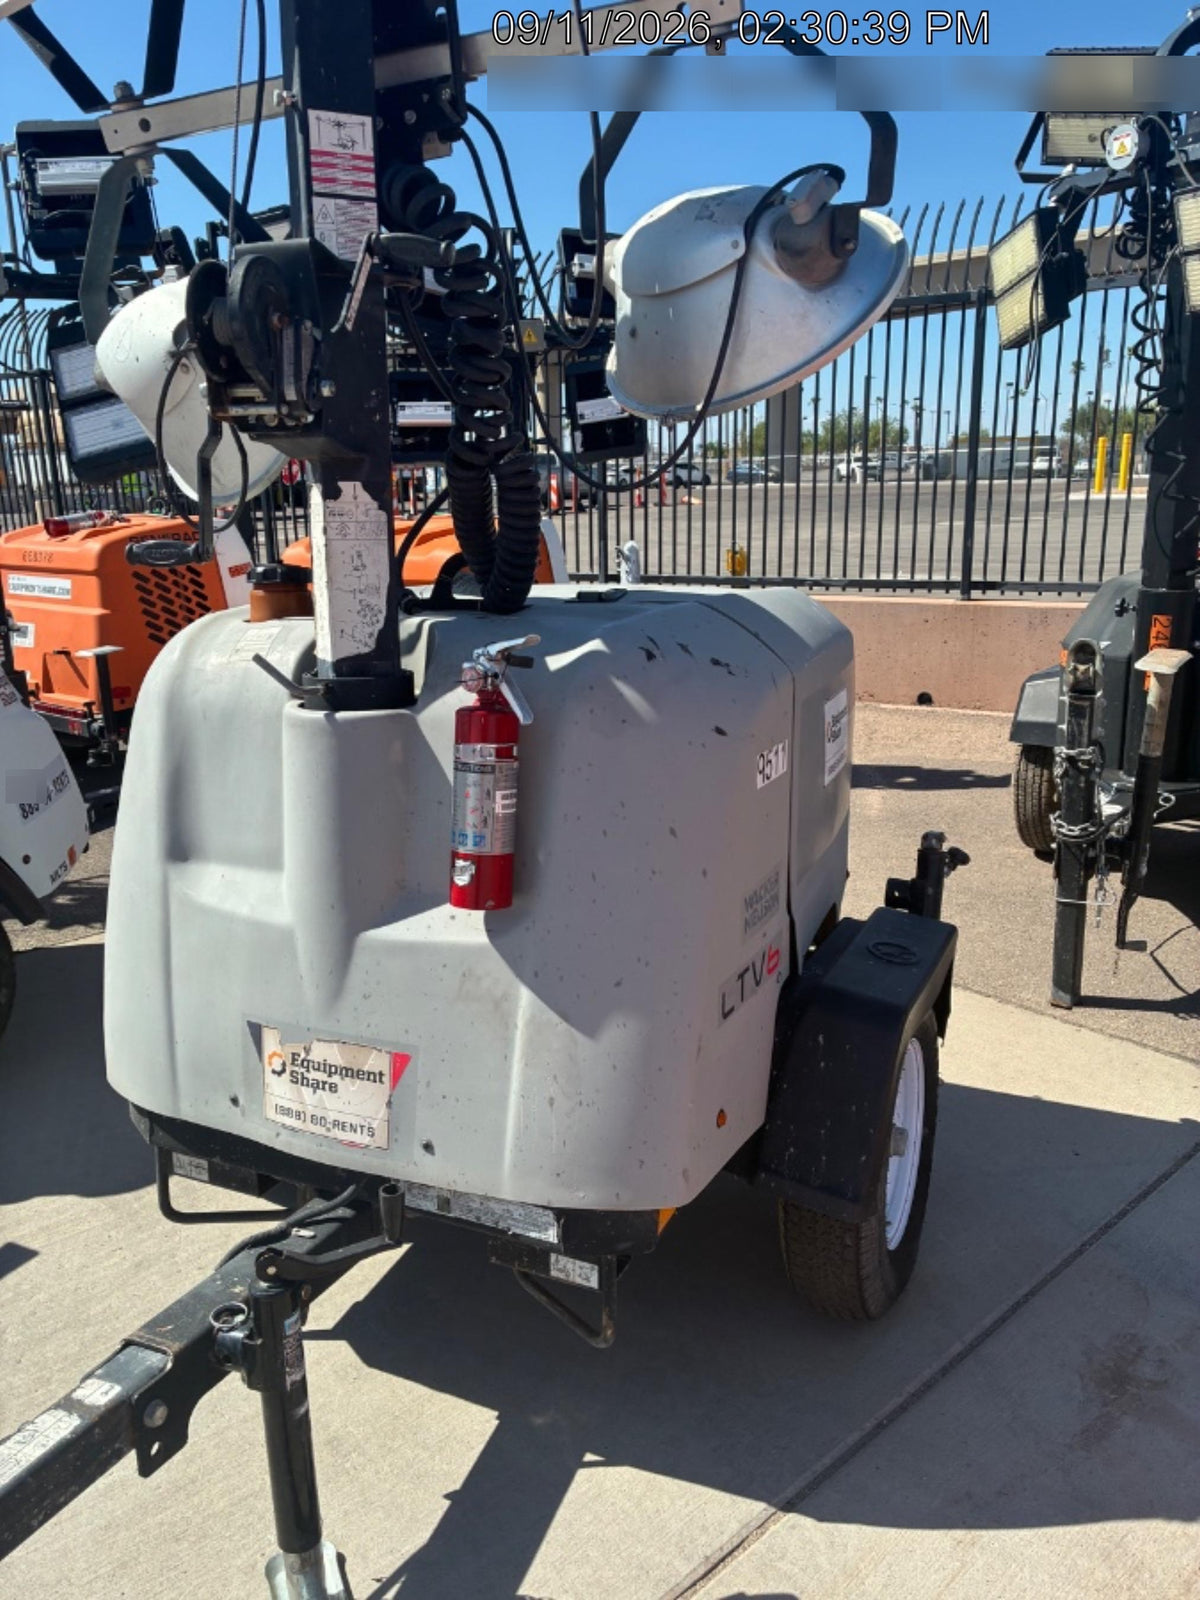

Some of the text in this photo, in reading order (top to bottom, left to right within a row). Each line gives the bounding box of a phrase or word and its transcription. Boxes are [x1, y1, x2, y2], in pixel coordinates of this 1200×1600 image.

[289, 1070, 339, 1094] Share
[290, 1051, 386, 1085] Equipment
[275, 1103, 376, 1138] (888) 80-RENTS
